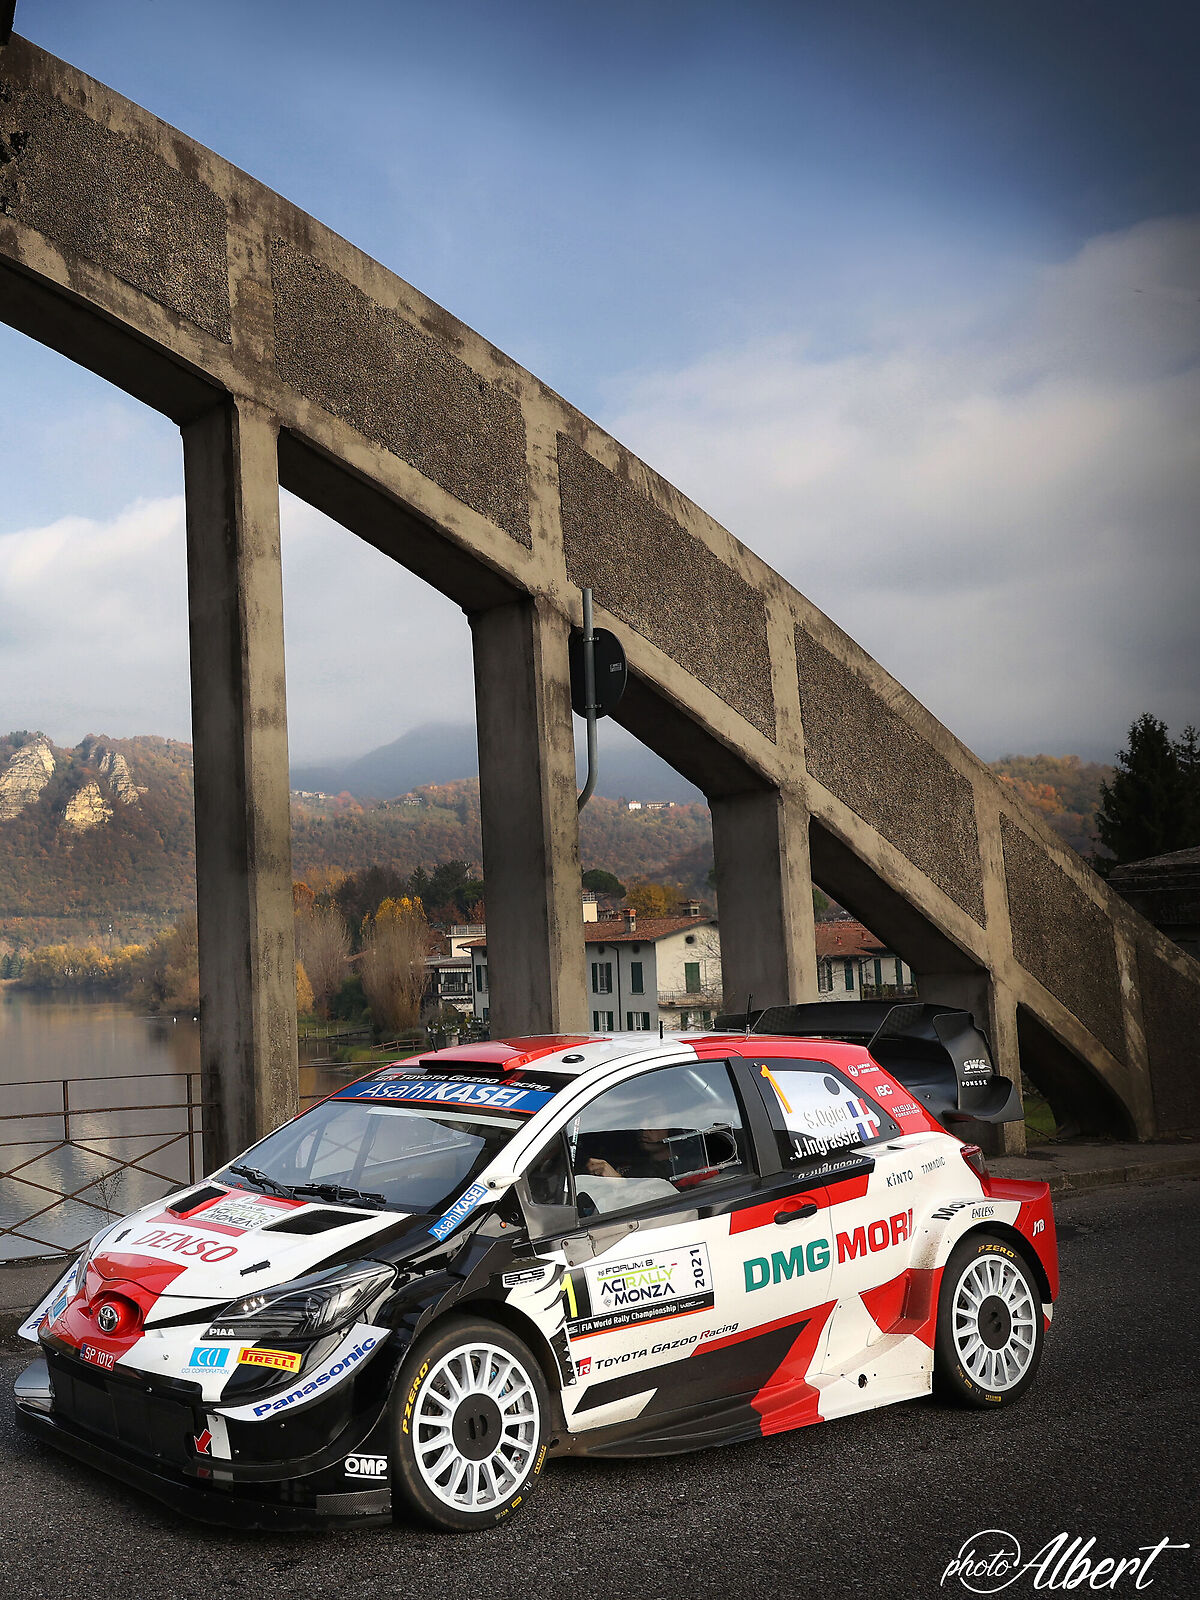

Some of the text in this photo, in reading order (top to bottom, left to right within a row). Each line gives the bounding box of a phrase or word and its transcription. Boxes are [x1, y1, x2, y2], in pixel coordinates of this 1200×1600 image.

[356, 1081, 531, 1107] AsahiKASEI
[500, 1079, 551, 1092] Racing
[760, 1064, 793, 1114] 1
[433, 1183, 486, 1240] AsahiKASEI
[130, 1229, 239, 1263] DENSO
[743, 1207, 913, 1293] DMG MORI
[605, 1261, 644, 1275] FORUM
[689, 1248, 706, 1289] 2021
[560, 1273, 579, 1318] 1
[614, 1282, 676, 1306] MONZA
[581, 1323, 593, 1332] FIA
[593, 1317, 612, 1329] World
[613, 1314, 631, 1325] Rally
[631, 1304, 677, 1320] Championship
[208, 1328, 235, 1337] PIAA
[594, 1349, 648, 1370] TOYOTA
[651, 1336, 698, 1354] GAZOO
[699, 1322, 740, 1340] Racing
[84, 1346, 114, 1369] SP 1012
[241, 1349, 297, 1369] PIRELLI
[252, 1337, 377, 1417] Panasonic
[344, 1457, 388, 1476] OMP
